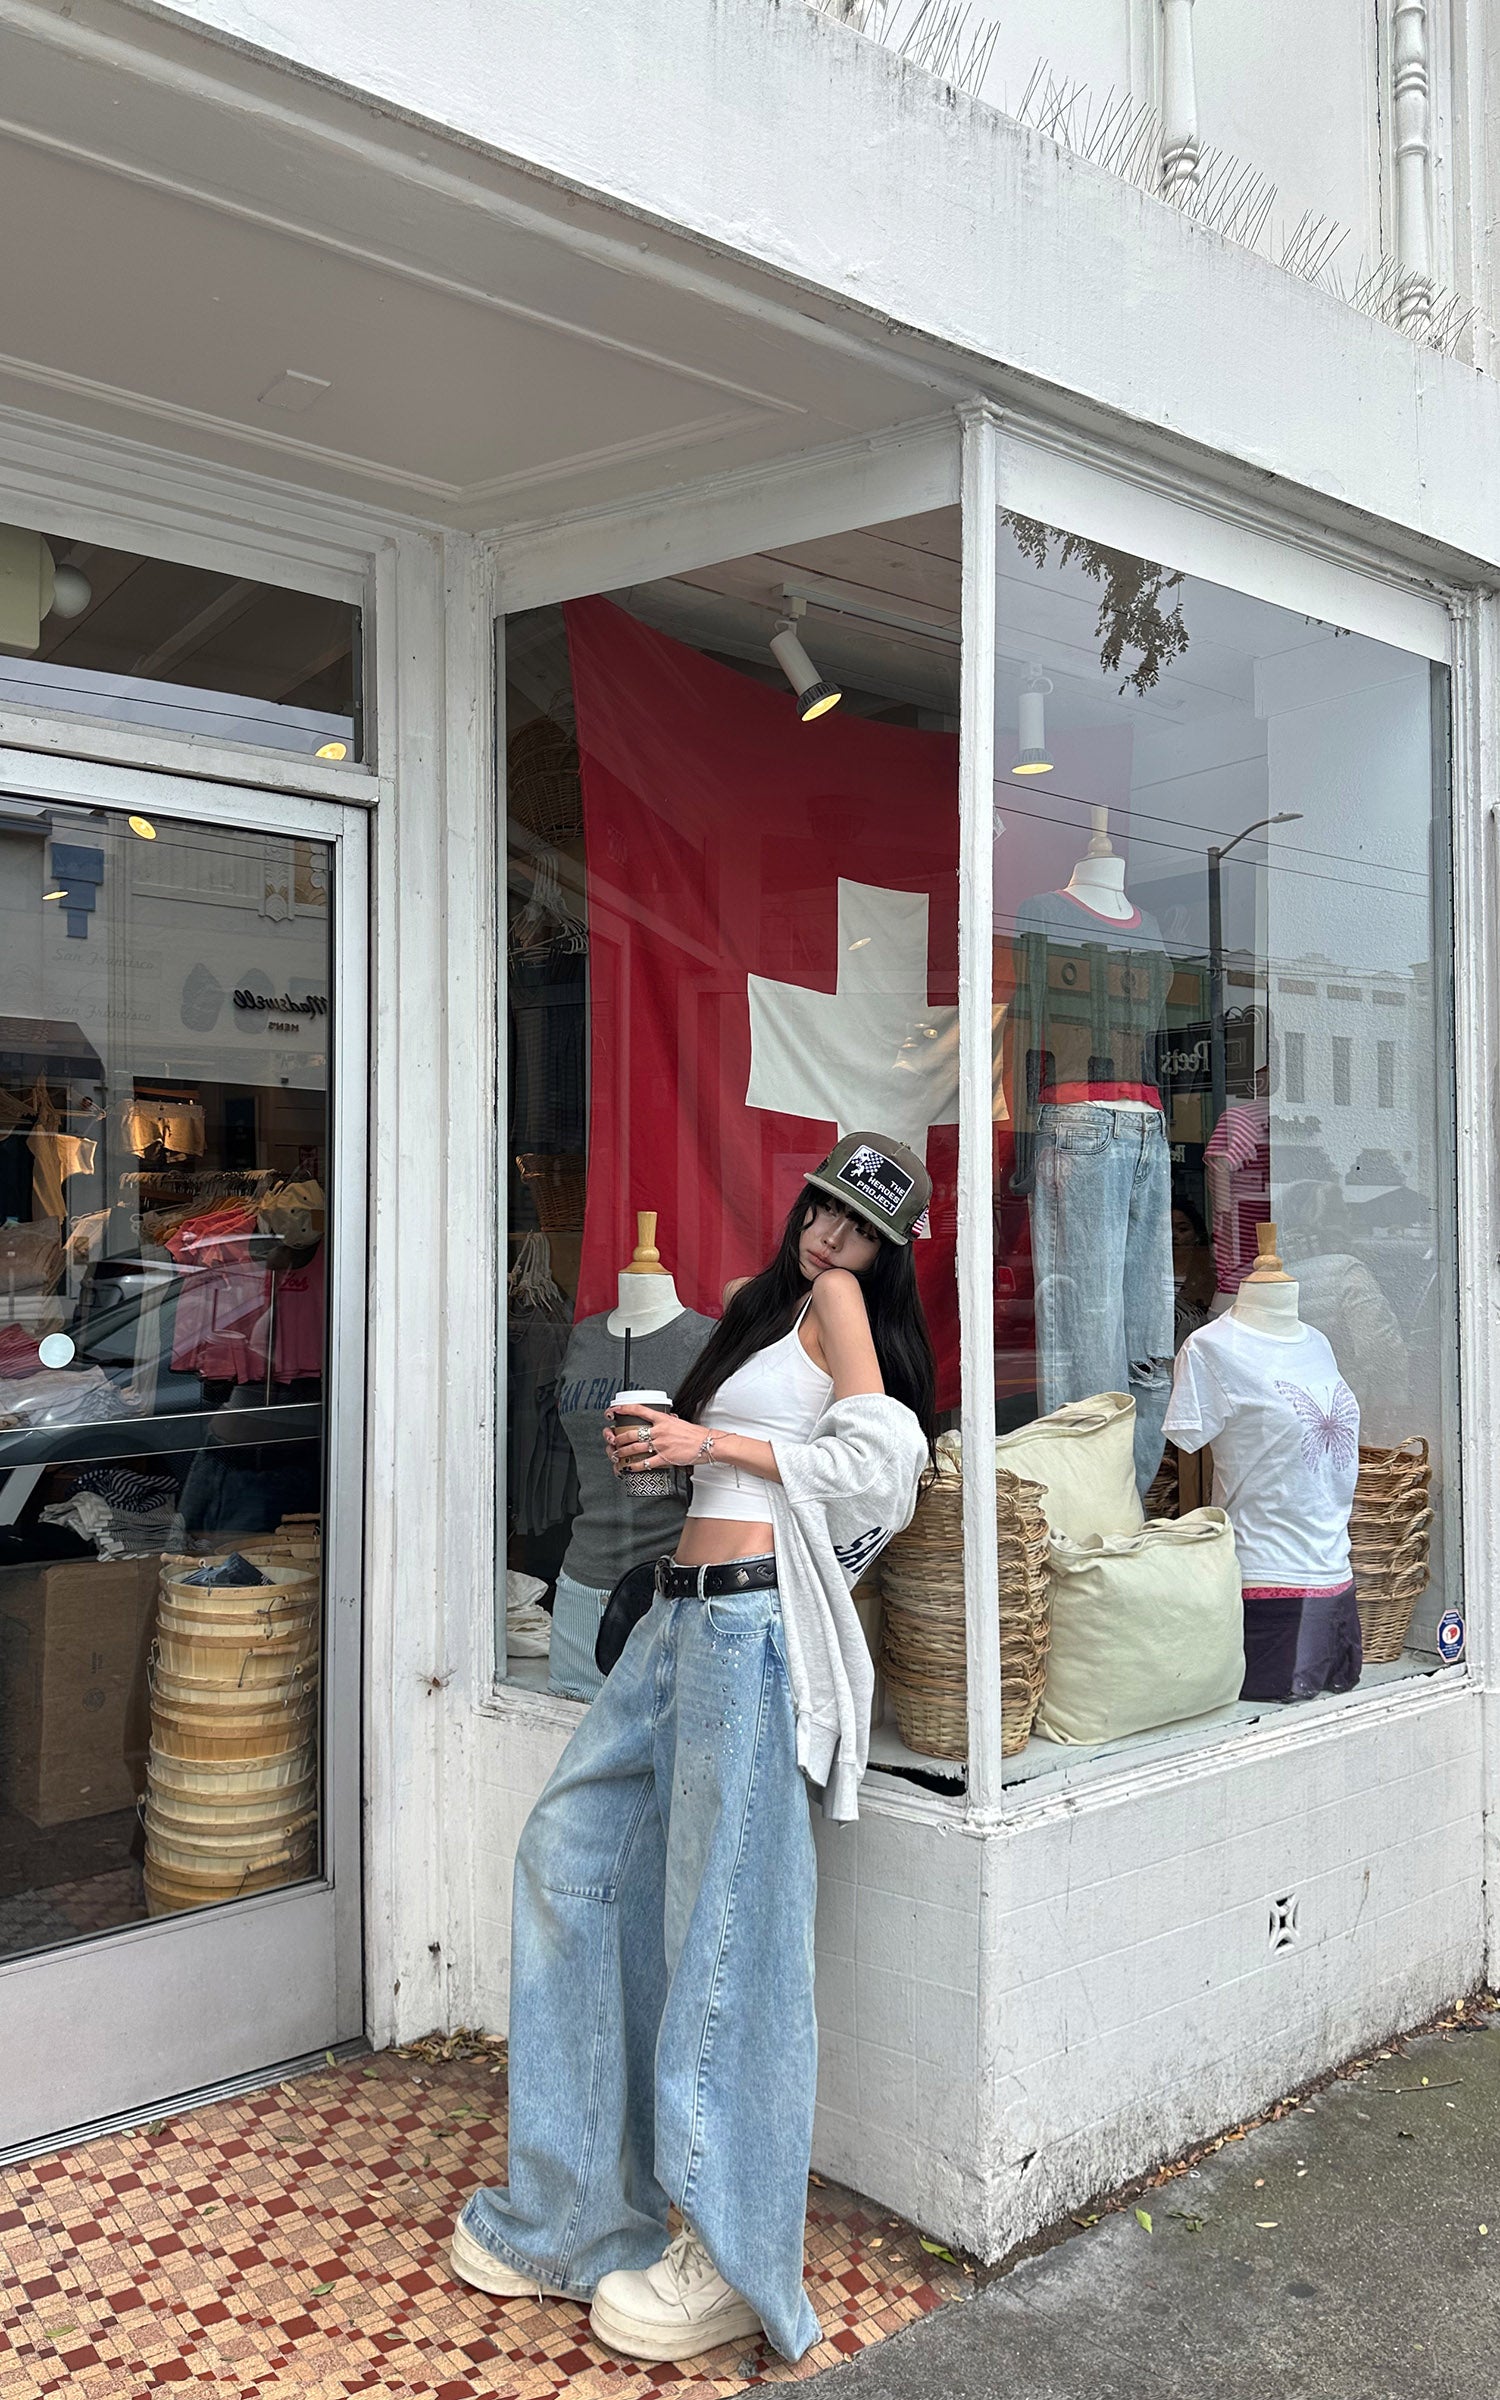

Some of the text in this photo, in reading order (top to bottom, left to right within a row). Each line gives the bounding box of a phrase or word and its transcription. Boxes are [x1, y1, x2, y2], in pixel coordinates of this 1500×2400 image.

[53, 948, 81, 962] San
[54, 1004, 80, 1017] San
[856, 1180, 896, 1211] PROJECT
[868, 1176, 900, 1204] HEROES
[890, 1180, 905, 1197] THE
[560, 1380, 586, 1415] AN
